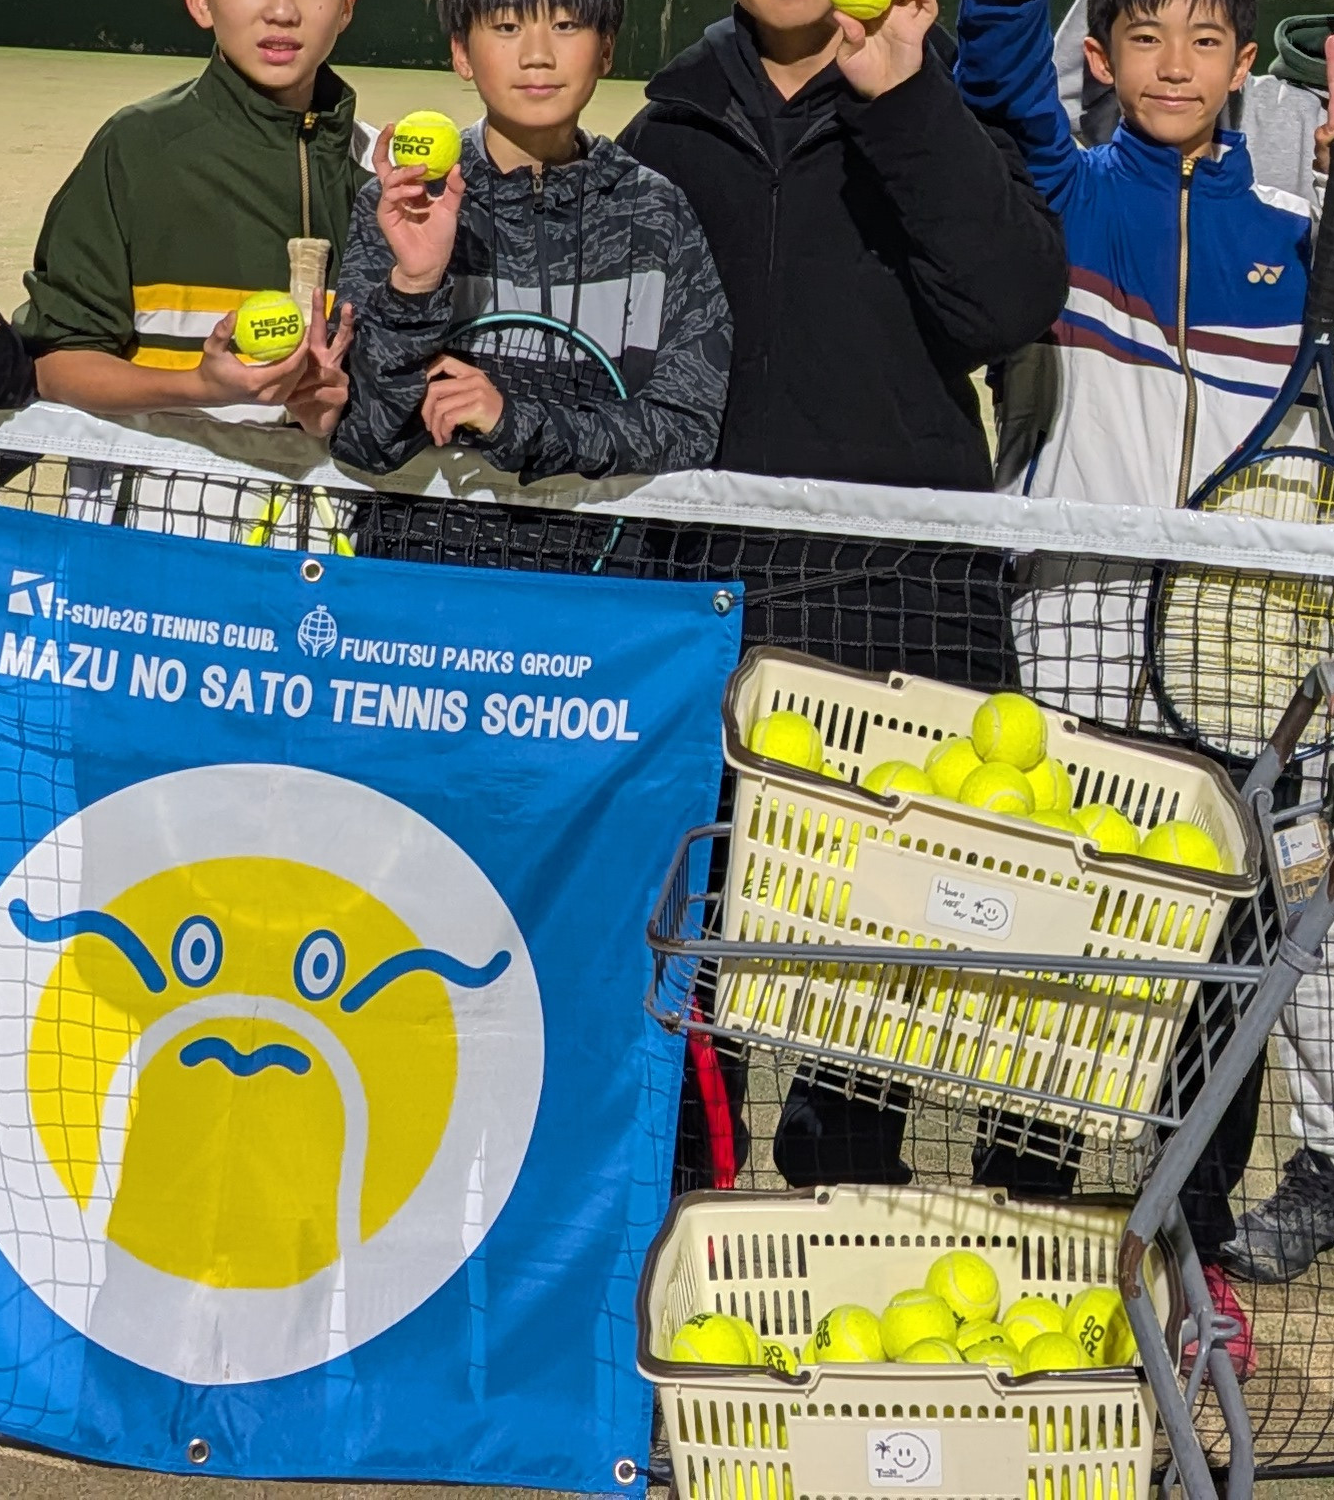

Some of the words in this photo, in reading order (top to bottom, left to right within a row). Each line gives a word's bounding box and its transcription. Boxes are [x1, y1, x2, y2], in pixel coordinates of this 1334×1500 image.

[393, 143, 431, 156] PRO
[250, 314, 300, 329] HEAD
[253, 323, 300, 341] PRO
[55, 597, 148, 634] T-style26
[151, 613, 220, 645] TENNIS
[223, 623, 279, 652] CLUB.
[339, 637, 437, 668] FUKUTSU
[441, 647, 515, 674] PARKS
[520, 652, 592, 679] GROUP
[128, 653, 187, 703] NO
[199, 664, 313, 718] SATO
[329, 678, 468, 733] TENNIS
[481, 692, 640, 742] SCHOOL
[1078, 1315, 1095, 1347] AD
[1085, 1324, 1105, 1359] RO
